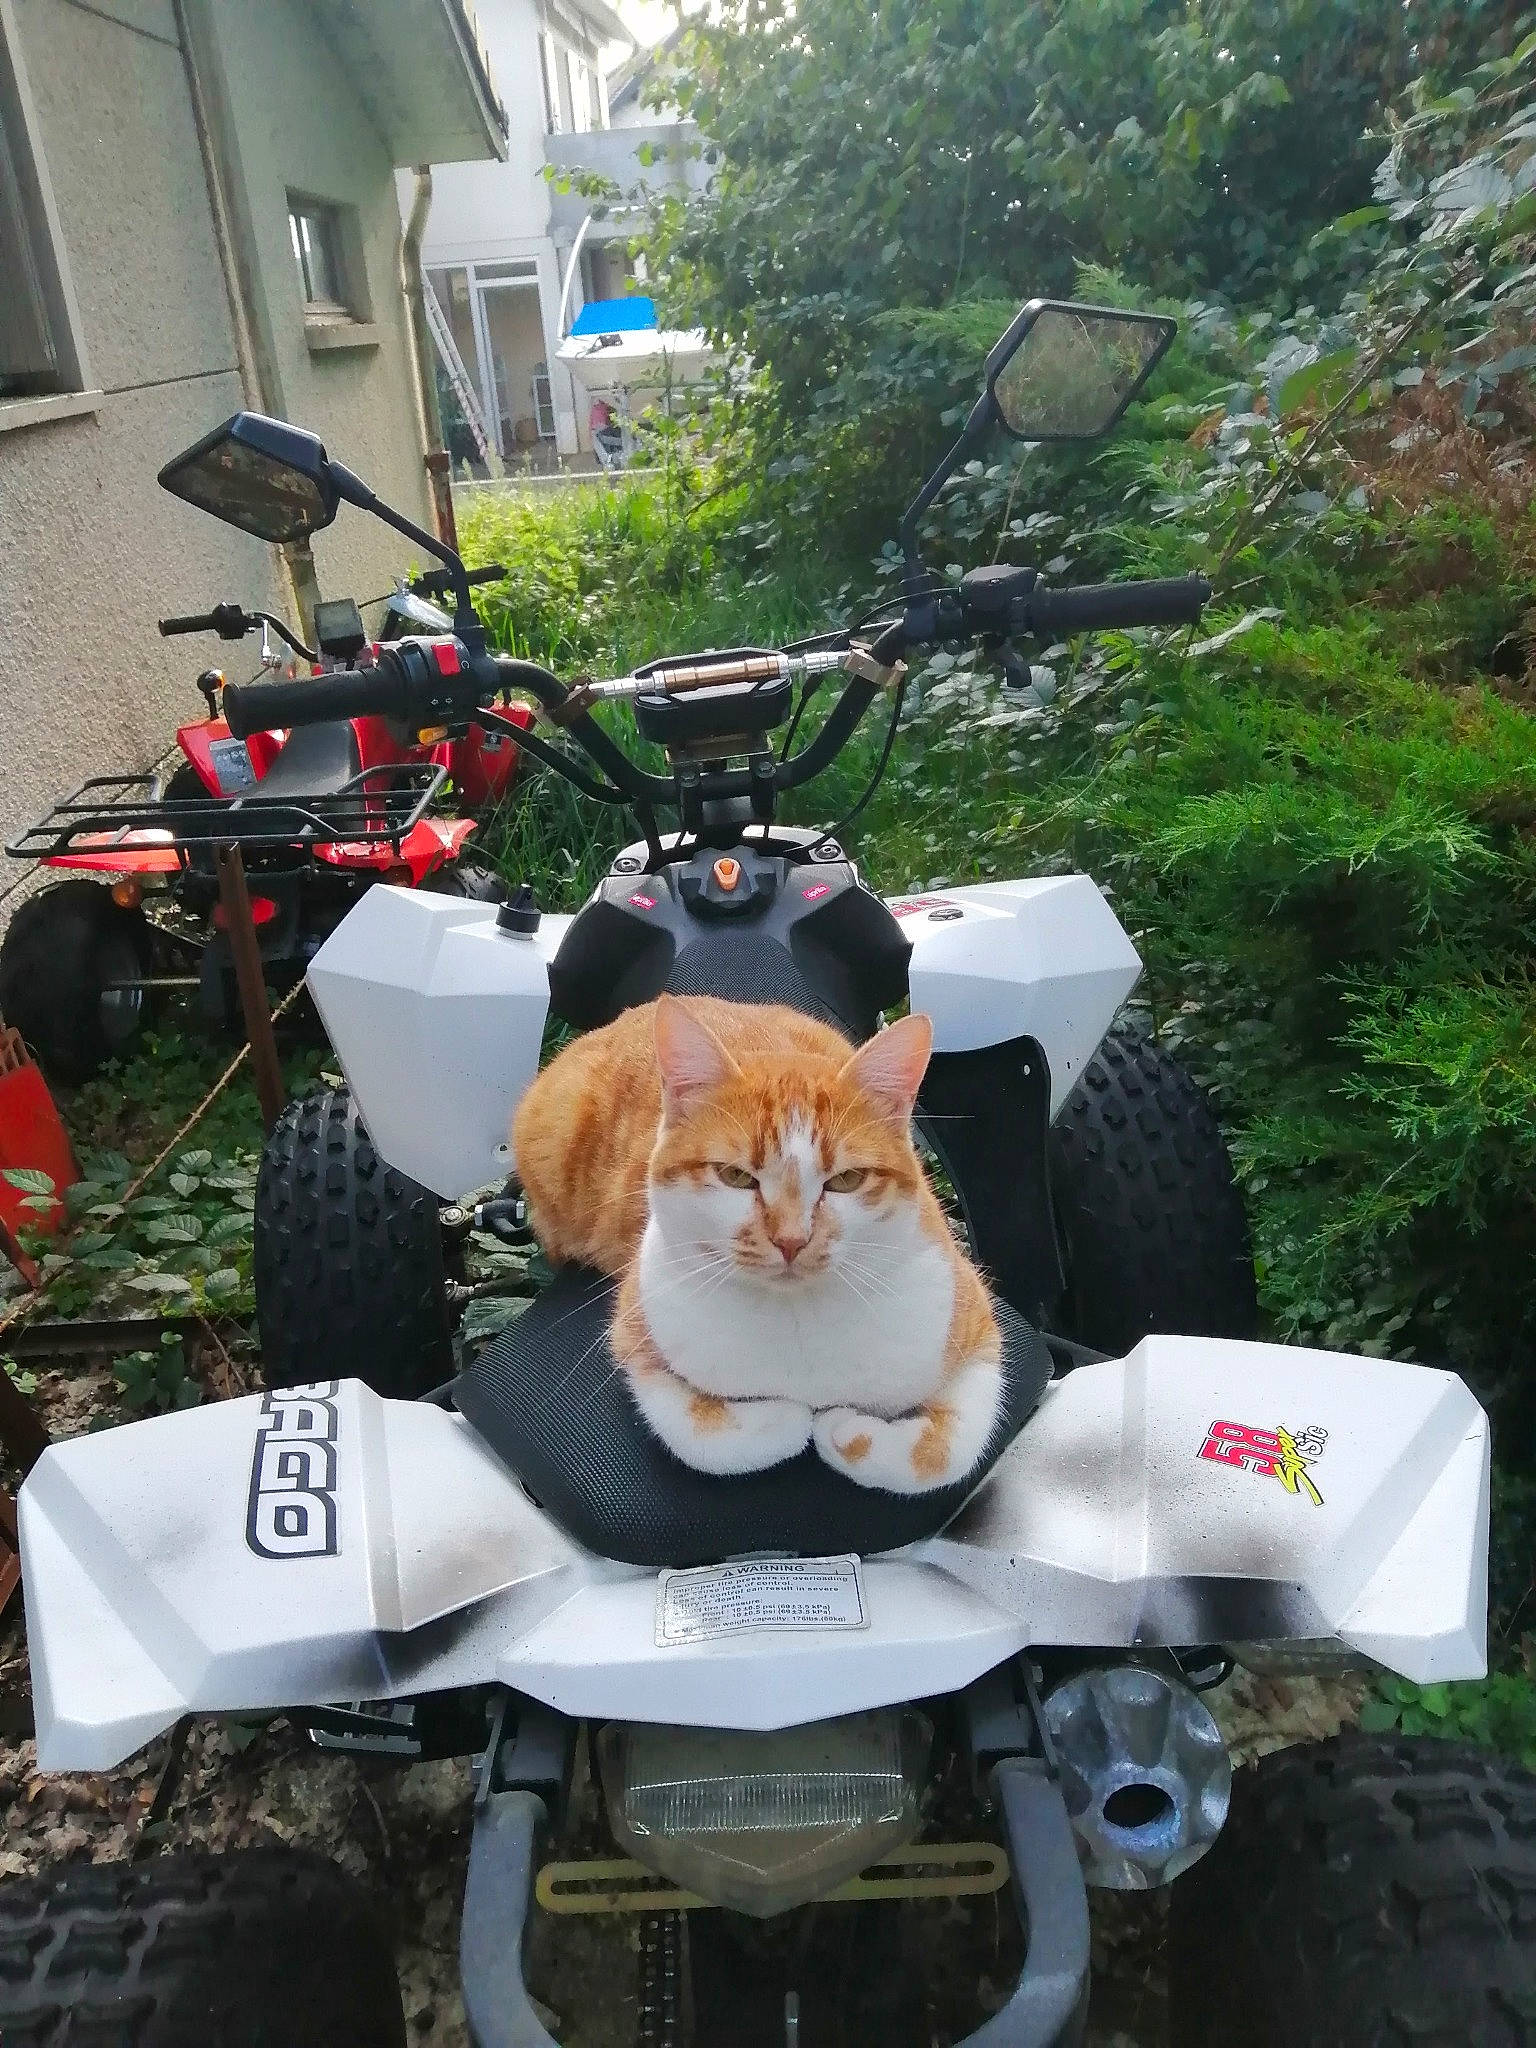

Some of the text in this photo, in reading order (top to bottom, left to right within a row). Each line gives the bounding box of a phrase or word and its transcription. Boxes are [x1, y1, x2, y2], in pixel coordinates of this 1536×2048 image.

[1196, 1420, 1284, 1478] 58
[737, 1565, 805, 1574] WARNING
[673, 1583, 715, 1595] Improper
[736, 1576, 778, 1585] pressure
[792, 1575, 849, 1583] overloading
